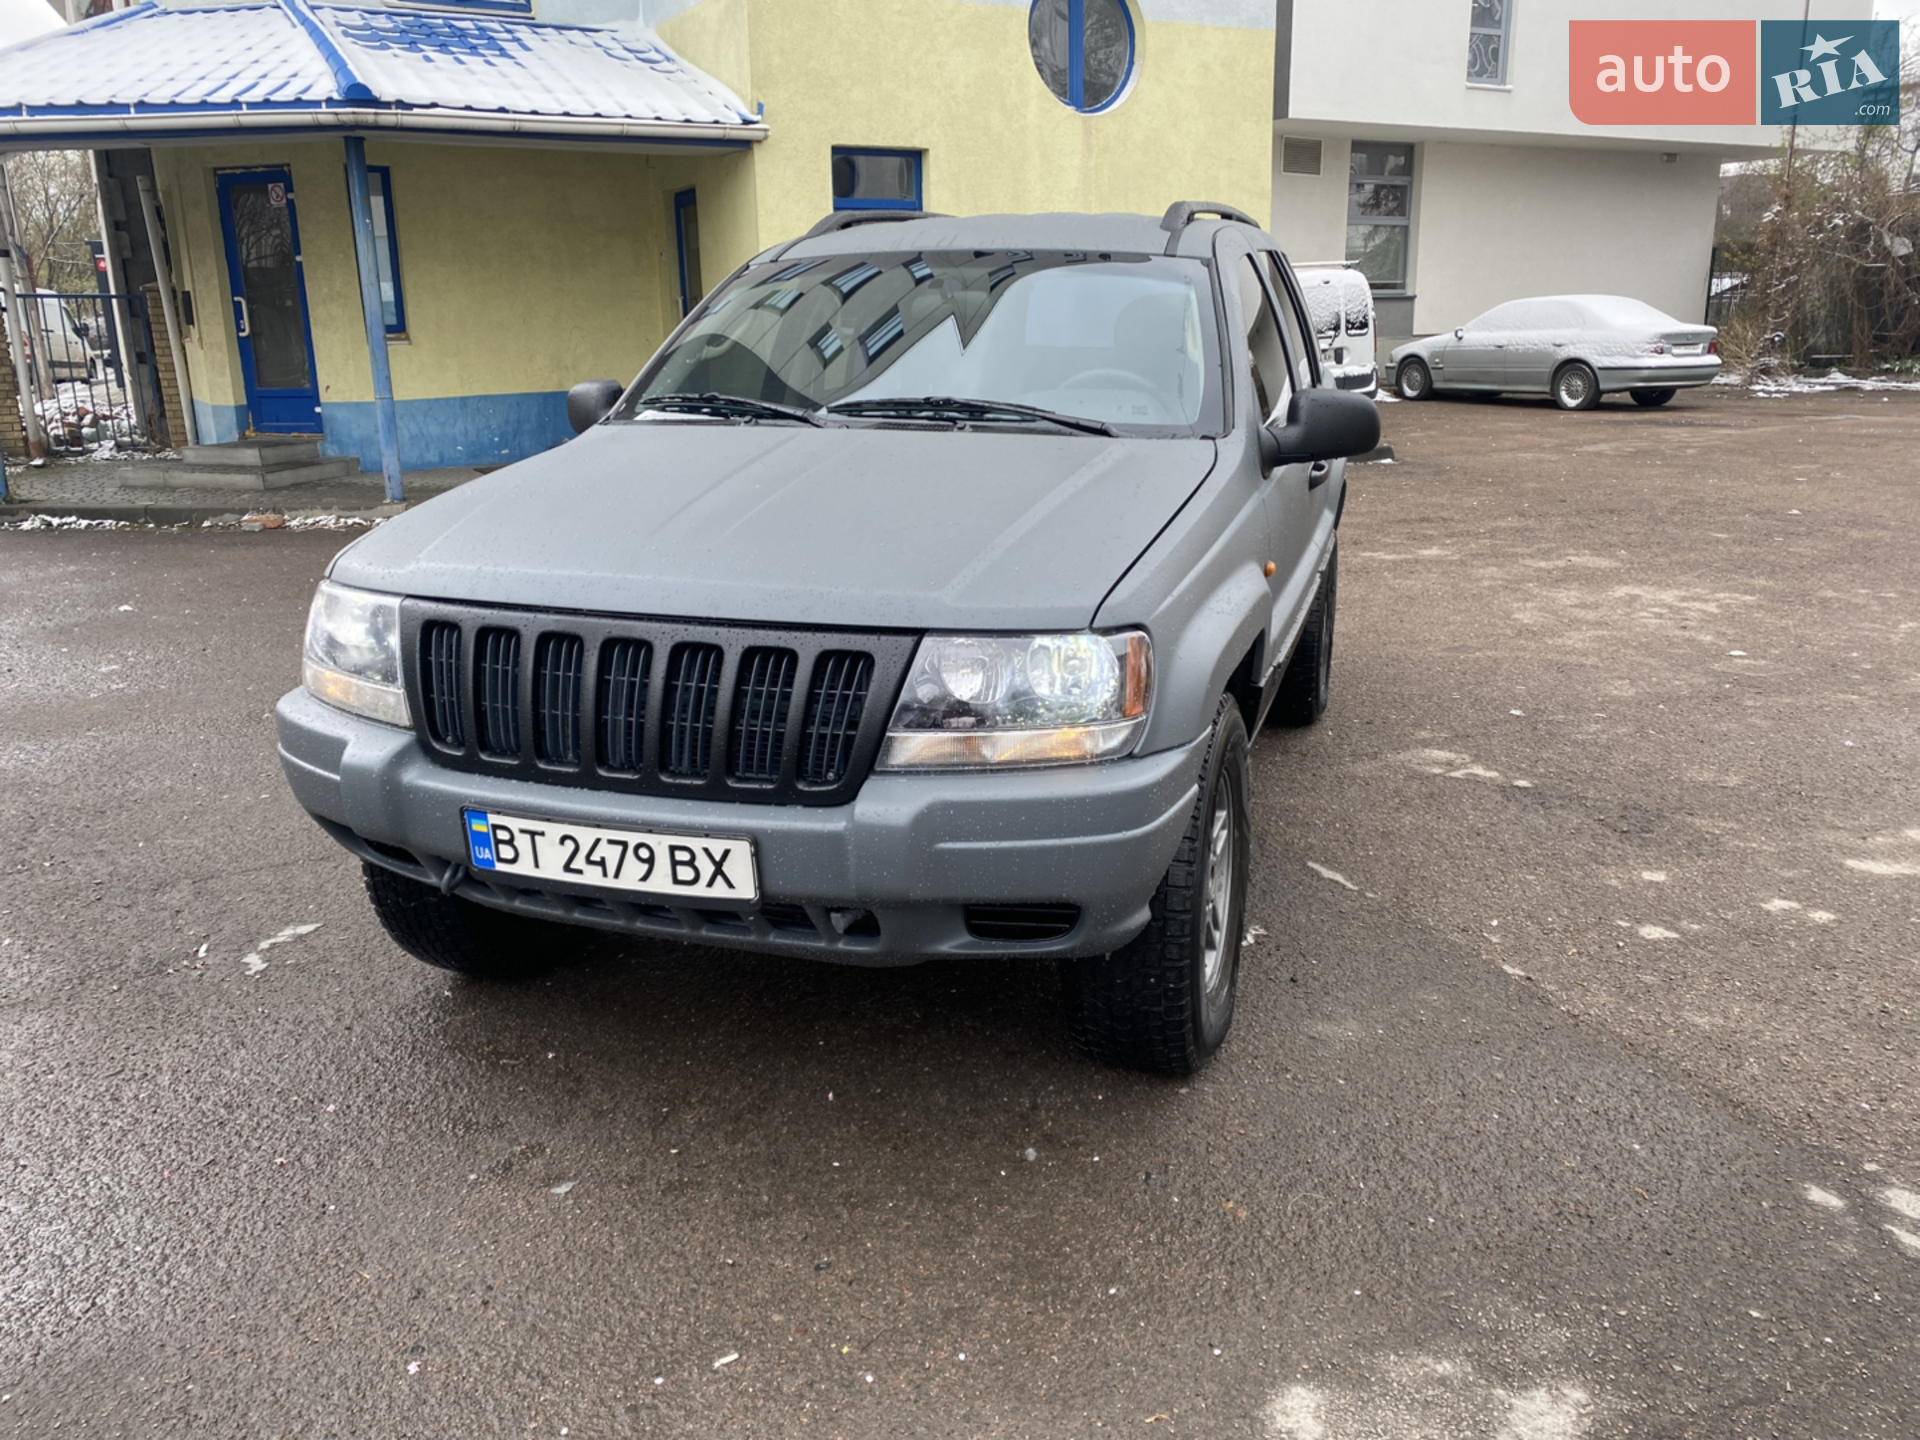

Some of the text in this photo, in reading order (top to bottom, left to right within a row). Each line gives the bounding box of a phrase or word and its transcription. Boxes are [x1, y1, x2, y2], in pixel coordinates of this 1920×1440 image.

[475, 845, 493, 861] UA
[490, 823, 736, 889] BT 2479 BX
